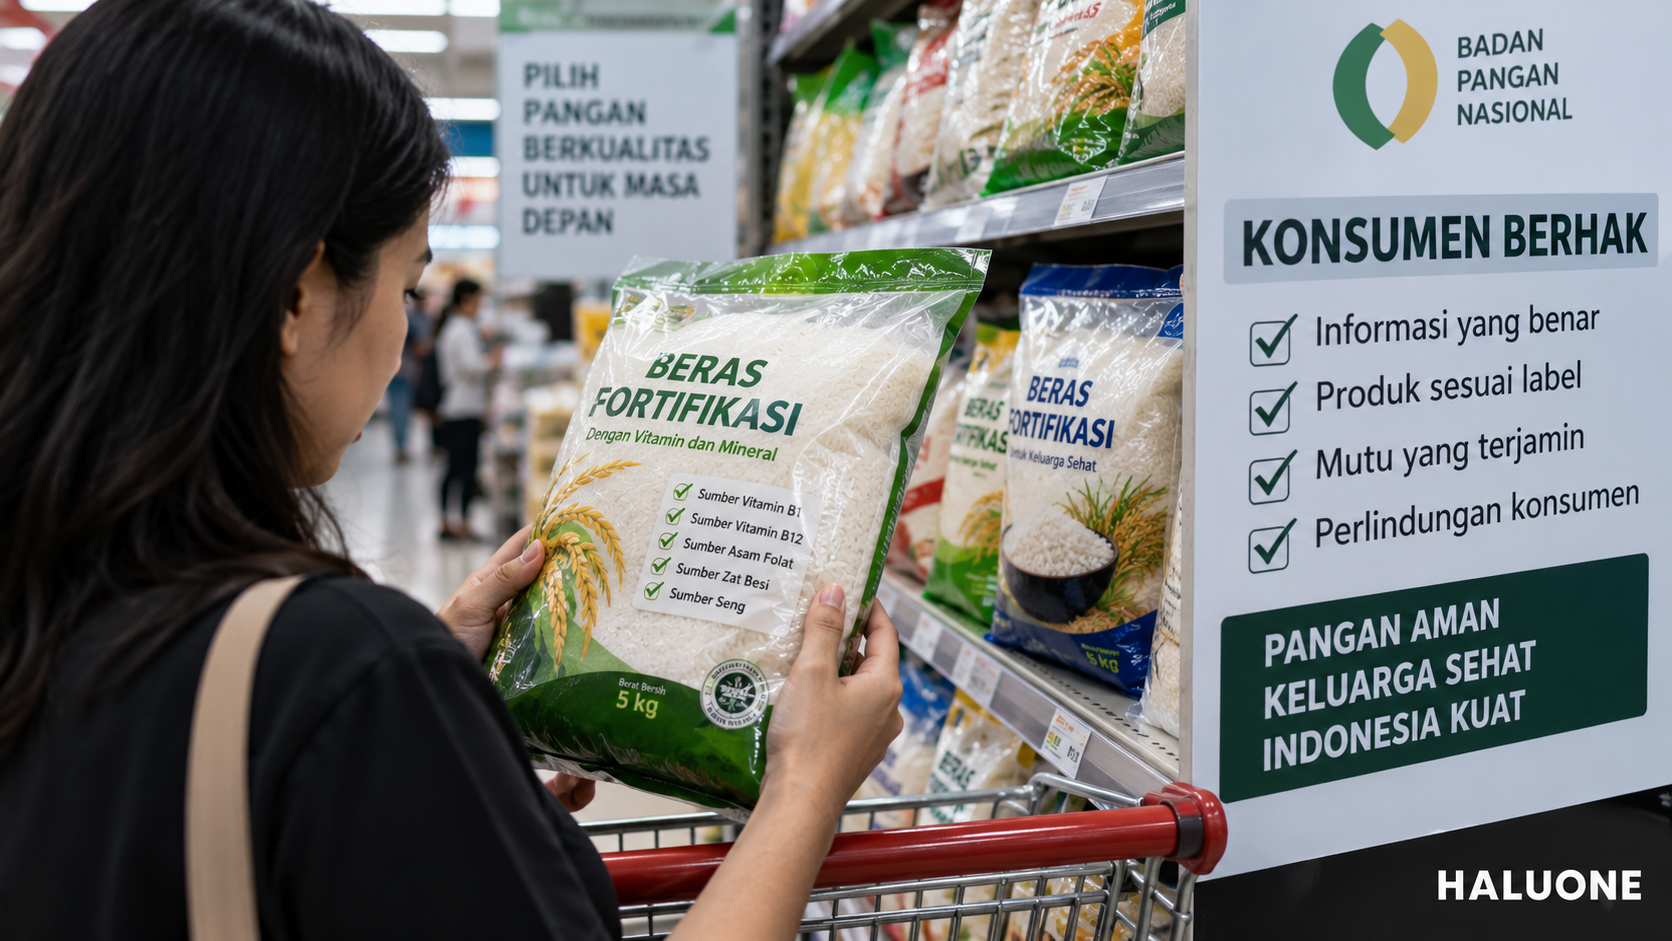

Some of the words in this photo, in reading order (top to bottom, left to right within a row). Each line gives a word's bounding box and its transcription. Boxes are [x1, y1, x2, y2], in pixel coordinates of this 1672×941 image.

[1456, 28, 1544, 59] BADAN
[523, 62, 600, 89] PILIH
[1456, 62, 1559, 92] PANGAN
[523, 99, 647, 125] PANGAN
[1456, 97, 1573, 126] NASIONAL
[522, 135, 711, 162] BERKUALITAS
[522, 172, 616, 197] UNTUK
[624, 172, 701, 197] MASA
[522, 208, 614, 235] DEPAN
[1242, 214, 1491, 267] KONSUMEN
[1503, 212, 1649, 258] BERHAK
[1316, 309, 1449, 346] Informasi
[1457, 311, 1520, 346] yang
[1529, 304, 1600, 334] benar
[645, 352, 769, 388] BERAS
[1317, 373, 1421, 411] Produk
[1430, 366, 1513, 402] sesuai
[1522, 360, 1582, 393] label
[1026, 375, 1094, 407] BERAS
[588, 386, 803, 437] FORTIFIKASI
[964, 397, 1005, 421] BERAS
[585, 427, 631, 444] Dengan
[634, 429, 685, 448] Vitamin
[687, 436, 716, 452] dan
[717, 439, 778, 461] Mineral
[1009, 408, 1116, 449] FORTIFIKASI
[1028, 449, 1065, 470] Keluarga
[1066, 455, 1098, 473] Sehat
[1316, 445, 1393, 480] Mutu
[1402, 439, 1470, 478] yang
[1478, 422, 1585, 465] terjamin
[697, 488, 740, 505] Sumber
[741, 495, 785, 514] Vitamin
[787, 504, 802, 518] B1
[1316, 501, 1502, 548] Perlindungan
[1511, 484, 1640, 522] konsumen
[690, 512, 733, 529] Sumber
[735, 520, 778, 539] Vitamin
[780, 529, 804, 546] B12
[683, 537, 726, 555] Sumber
[727, 545, 761, 562] Asam
[763, 552, 795, 570] Folat
[675, 562, 720, 580] Sumber
[721, 570, 742, 584] Zat
[744, 575, 770, 591] Besi
[669, 587, 714, 605] Sumber
[715, 595, 746, 615] Seng
[1264, 613, 1401, 667] PANGAN
[1410, 598, 1500, 643] AMAN
[618, 677, 640, 690] Berat
[641, 682, 667, 696] Bersih
[1264, 658, 1437, 720] KELUARGA
[1445, 640, 1537, 686] SEHAT
[616, 690, 629, 709] 5
[633, 692, 659, 719] kg
[1263, 707, 1442, 772] INDONESIA
[1450, 689, 1527, 734] KUAT
